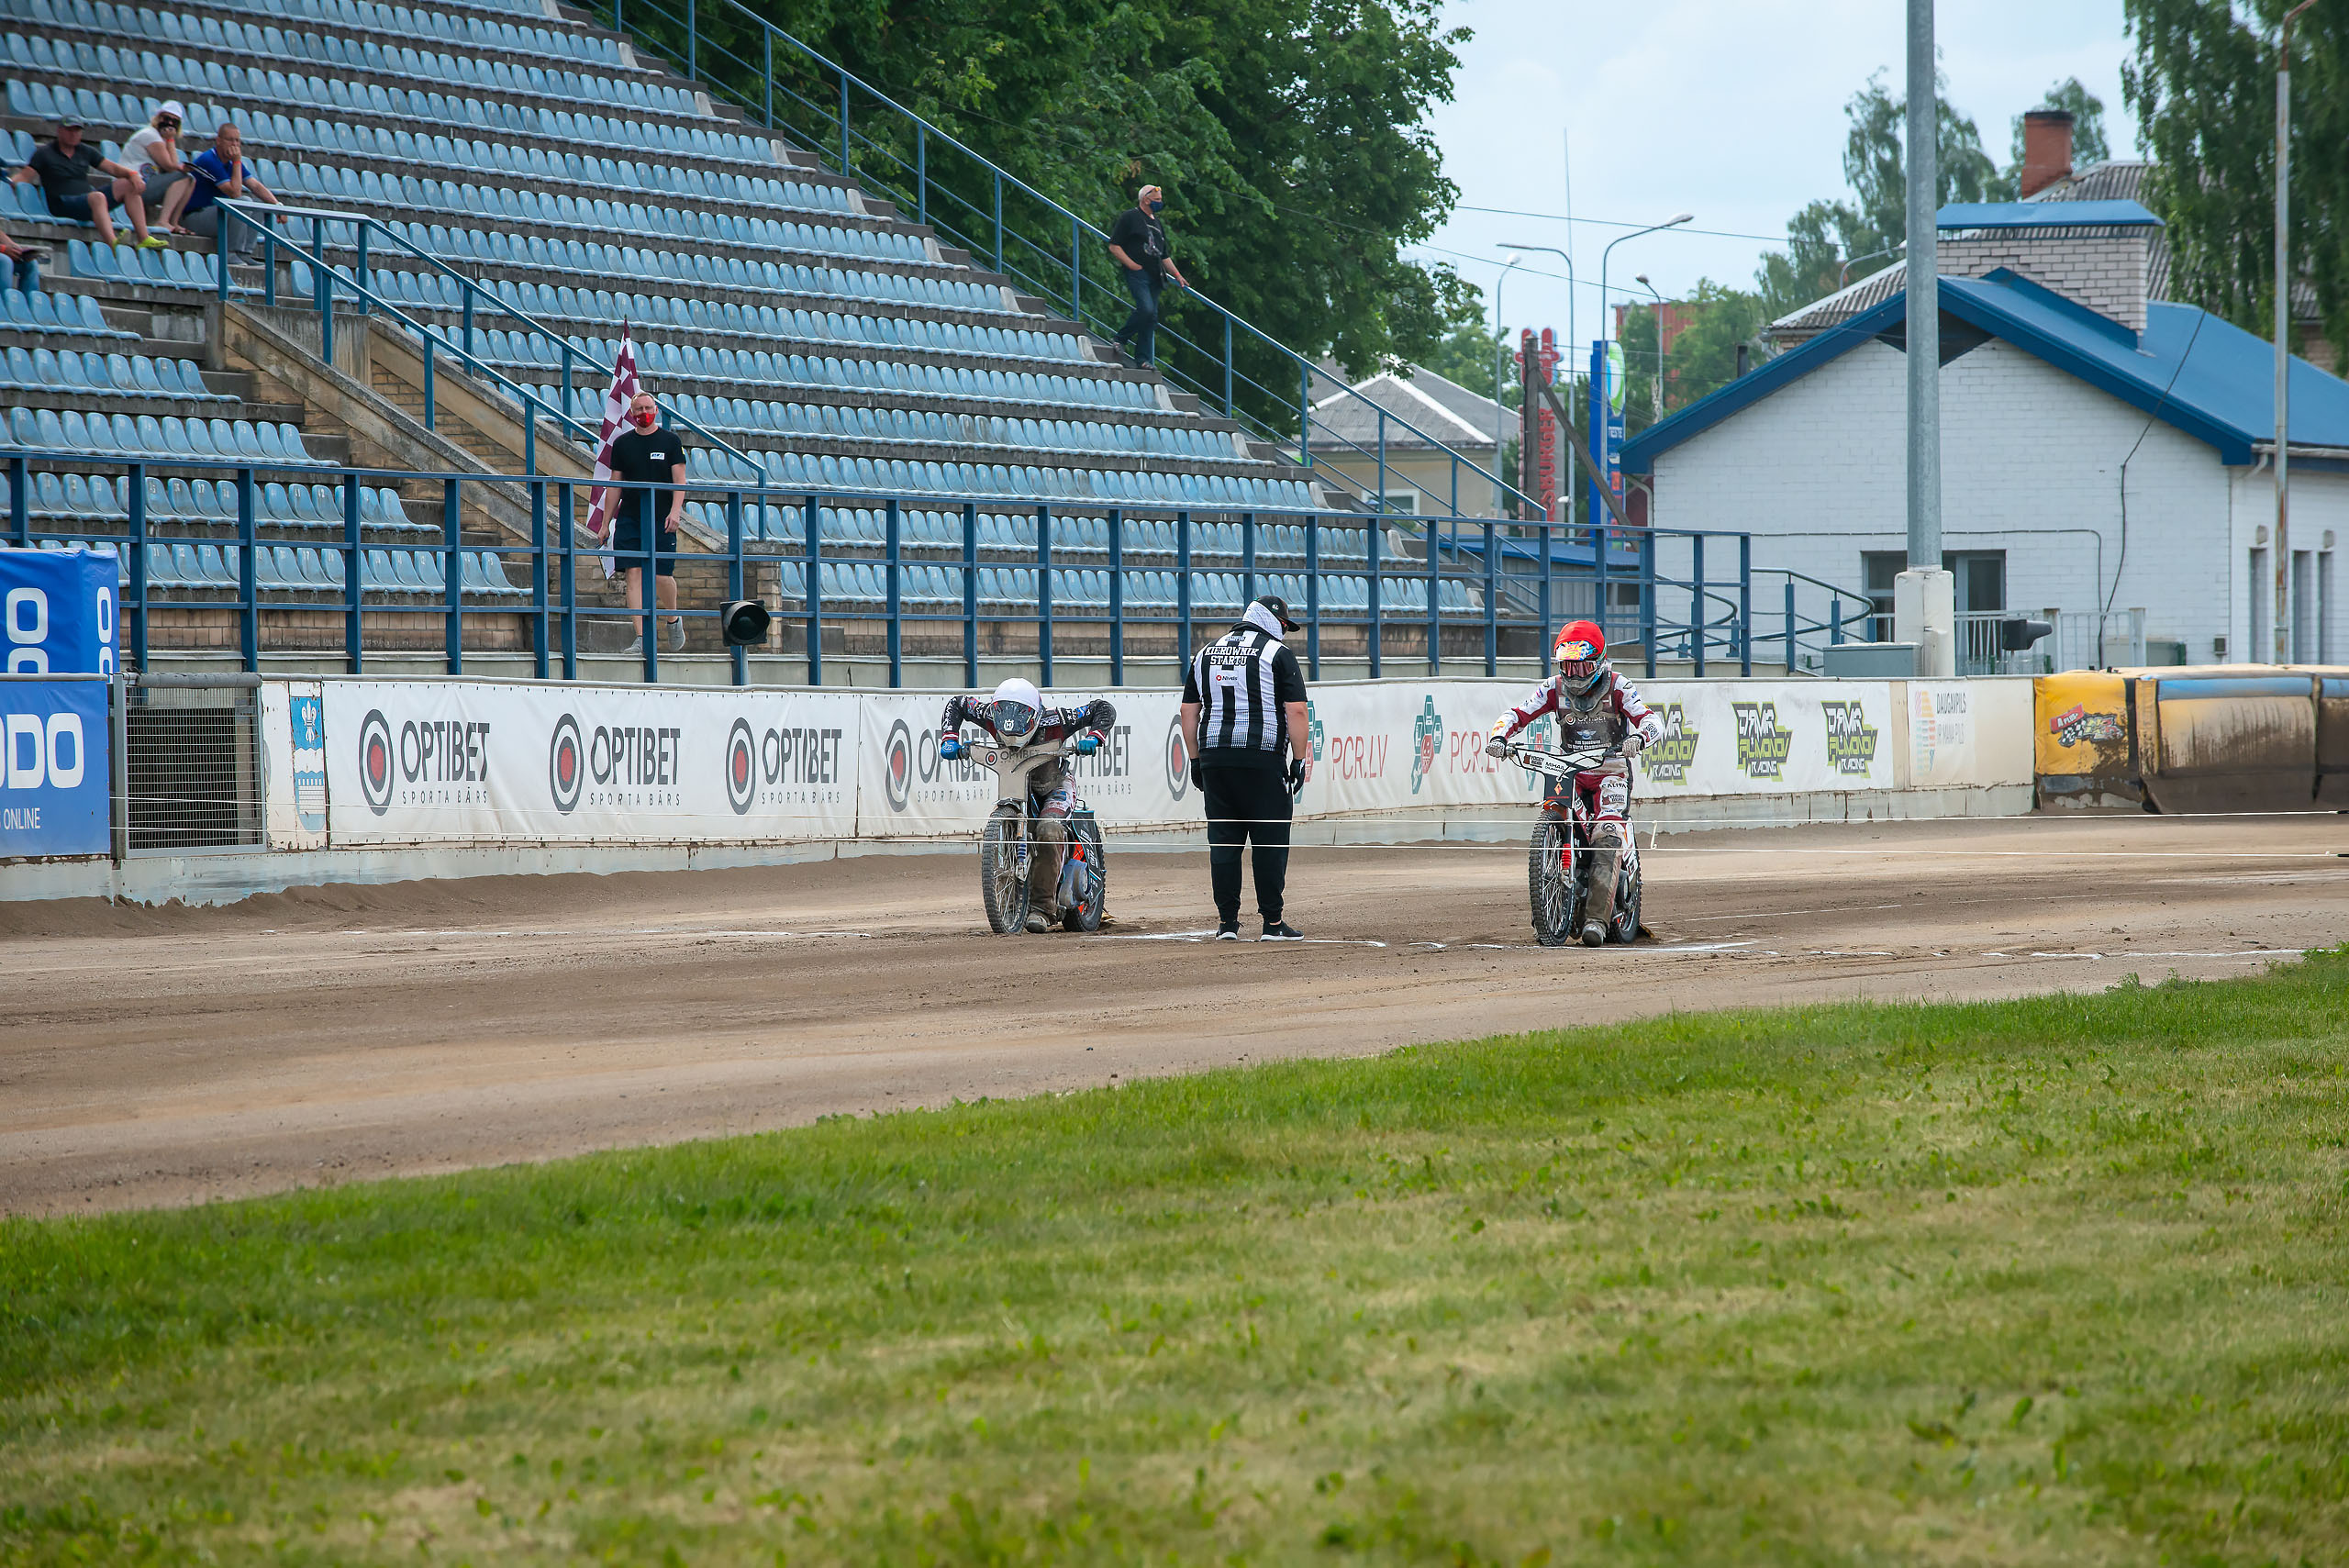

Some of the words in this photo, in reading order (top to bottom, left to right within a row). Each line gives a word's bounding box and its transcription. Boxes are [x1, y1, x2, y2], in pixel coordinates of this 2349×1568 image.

[1205, 646, 1259, 657] KIEROWNIK
[1210, 656, 1248, 665] STARTU
[1936, 692, 1966, 715] DAUGAVPILS
[0, 712, 83, 789] DO
[401, 720, 490, 783] OPTIBET
[590, 726, 681, 784] OPTIBET
[762, 728, 842, 784] OPTIBET
[1331, 734, 1388, 781] PCR.LV
[402, 790, 450, 805] SPORTA
[762, 791, 806, 805] SPORTA
[918, 790, 961, 803] SPORTA
[1076, 784, 1101, 796] ORTA
[590, 793, 641, 806] SPORTA
[3, 807, 41, 829] ONLINE
